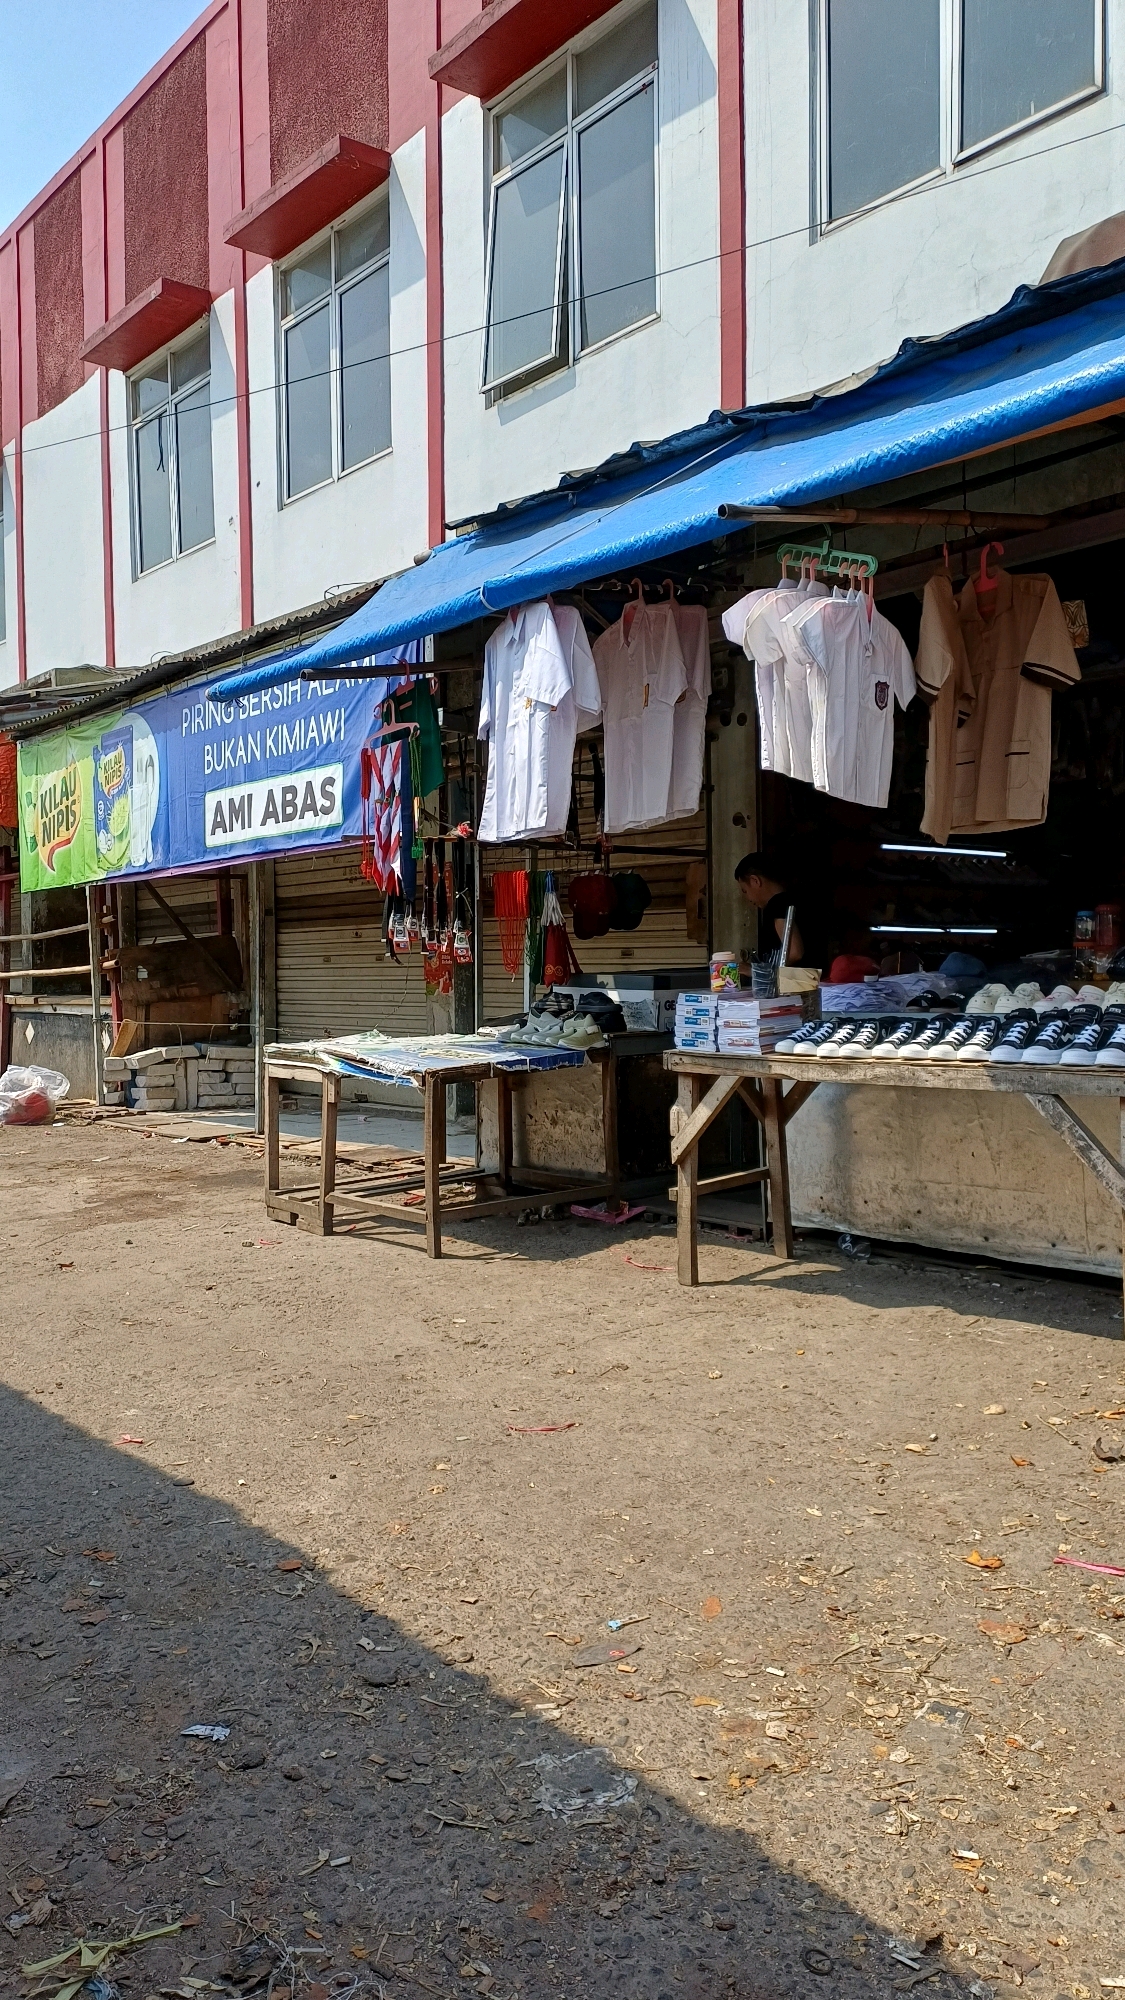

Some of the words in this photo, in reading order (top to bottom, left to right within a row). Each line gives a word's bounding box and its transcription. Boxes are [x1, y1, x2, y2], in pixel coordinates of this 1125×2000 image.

[182, 700, 234, 738] PIRING
[239, 678, 301, 720] BERSIH
[103, 750, 123, 774] KILAU
[204, 731, 260, 775] BUKAN
[265, 707, 345, 759] KIMIAWI
[39, 767, 77, 820] KILAU
[104, 765, 122, 789] NIPIS
[41, 798, 77, 848] NIPIS
[210, 793, 253, 836] AMI
[260, 776, 336, 827] ABAS
